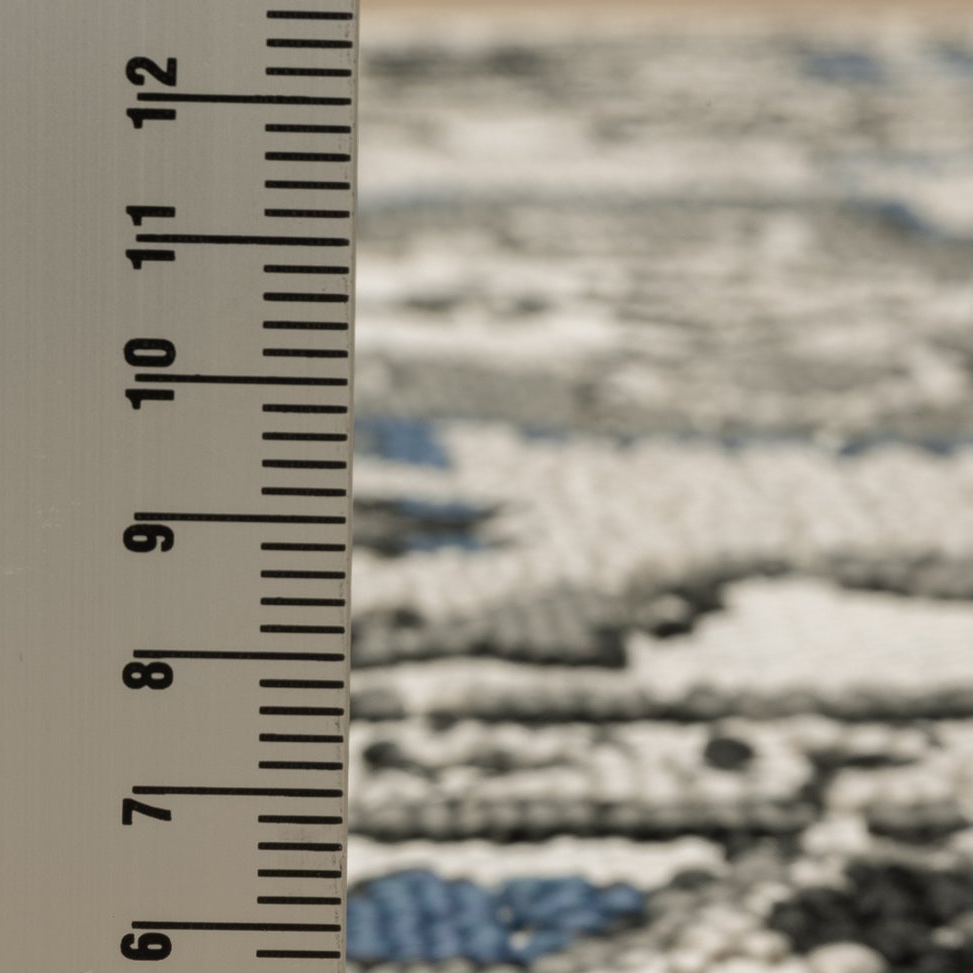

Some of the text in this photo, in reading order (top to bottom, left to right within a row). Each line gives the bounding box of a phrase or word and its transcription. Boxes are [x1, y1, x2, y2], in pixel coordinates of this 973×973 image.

[125, 56, 178, 130] 12
[125, 205, 176, 271] 11
[123, 337, 177, 411] 10
[123, 523, 175, 553] 9
[121, 661, 174, 691] 8
[121, 797, 172, 826] 7
[119, 932, 173, 962] 6
